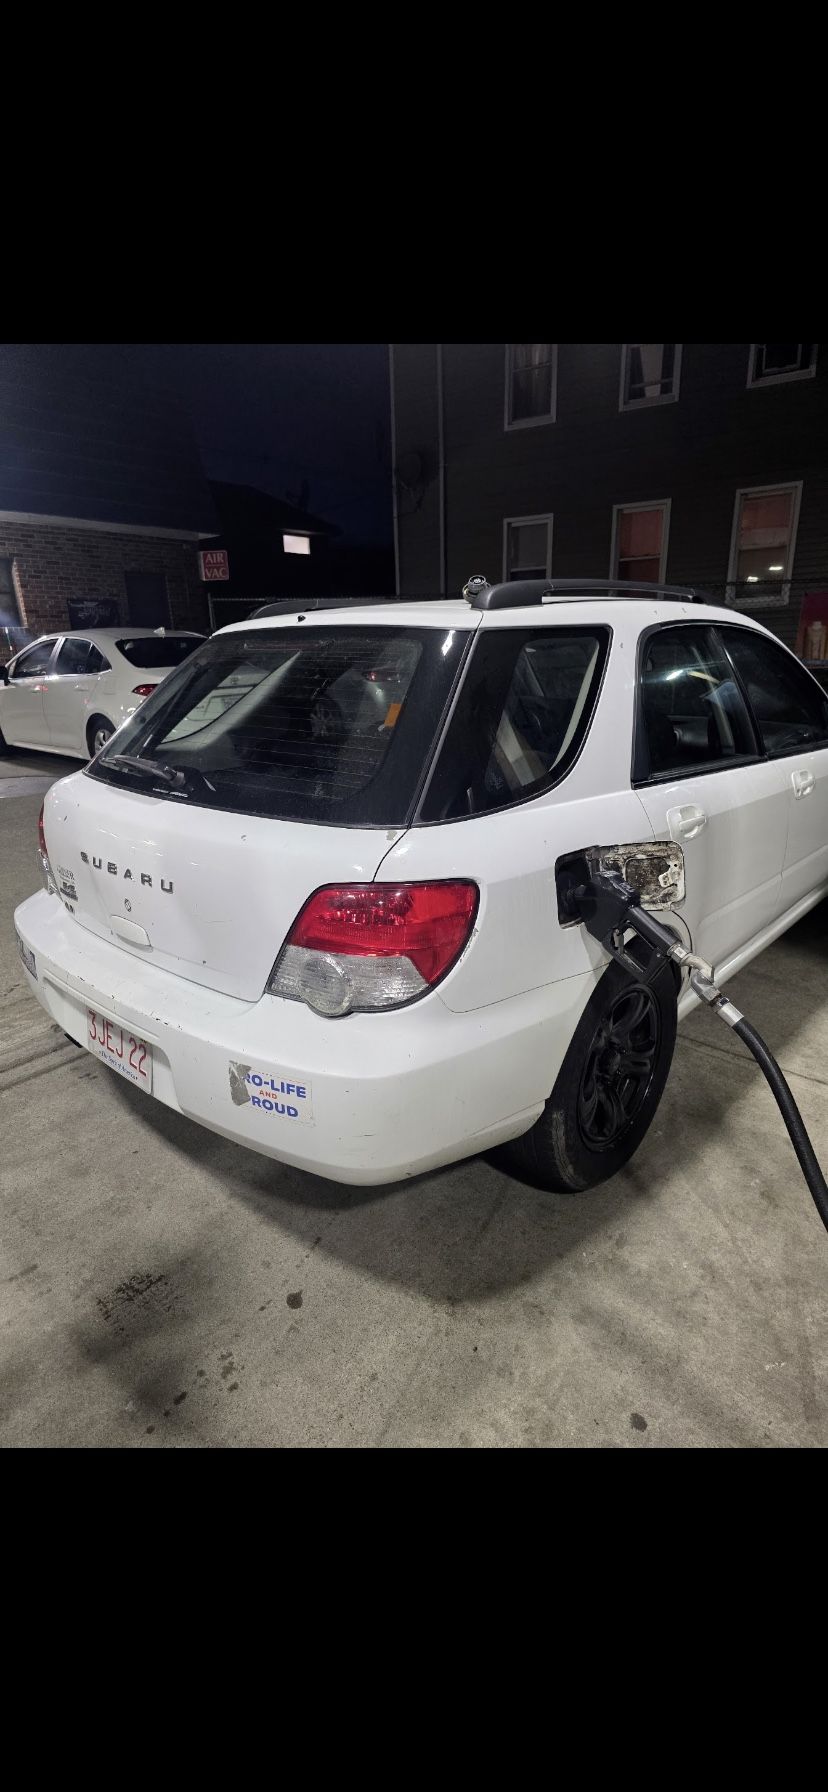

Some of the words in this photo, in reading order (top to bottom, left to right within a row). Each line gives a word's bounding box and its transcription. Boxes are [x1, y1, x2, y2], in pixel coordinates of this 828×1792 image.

[205, 553, 224, 563] AIR
[205, 567, 227, 578] VAC
[80, 851, 174, 895] SUBARU
[88, 1009, 123, 1058] 3JEJ
[129, 1037, 147, 1077] 22
[243, 1073, 307, 1098] RO-LIFE
[259, 1089, 278, 1100] AND
[250, 1095, 299, 1118] ROUD
